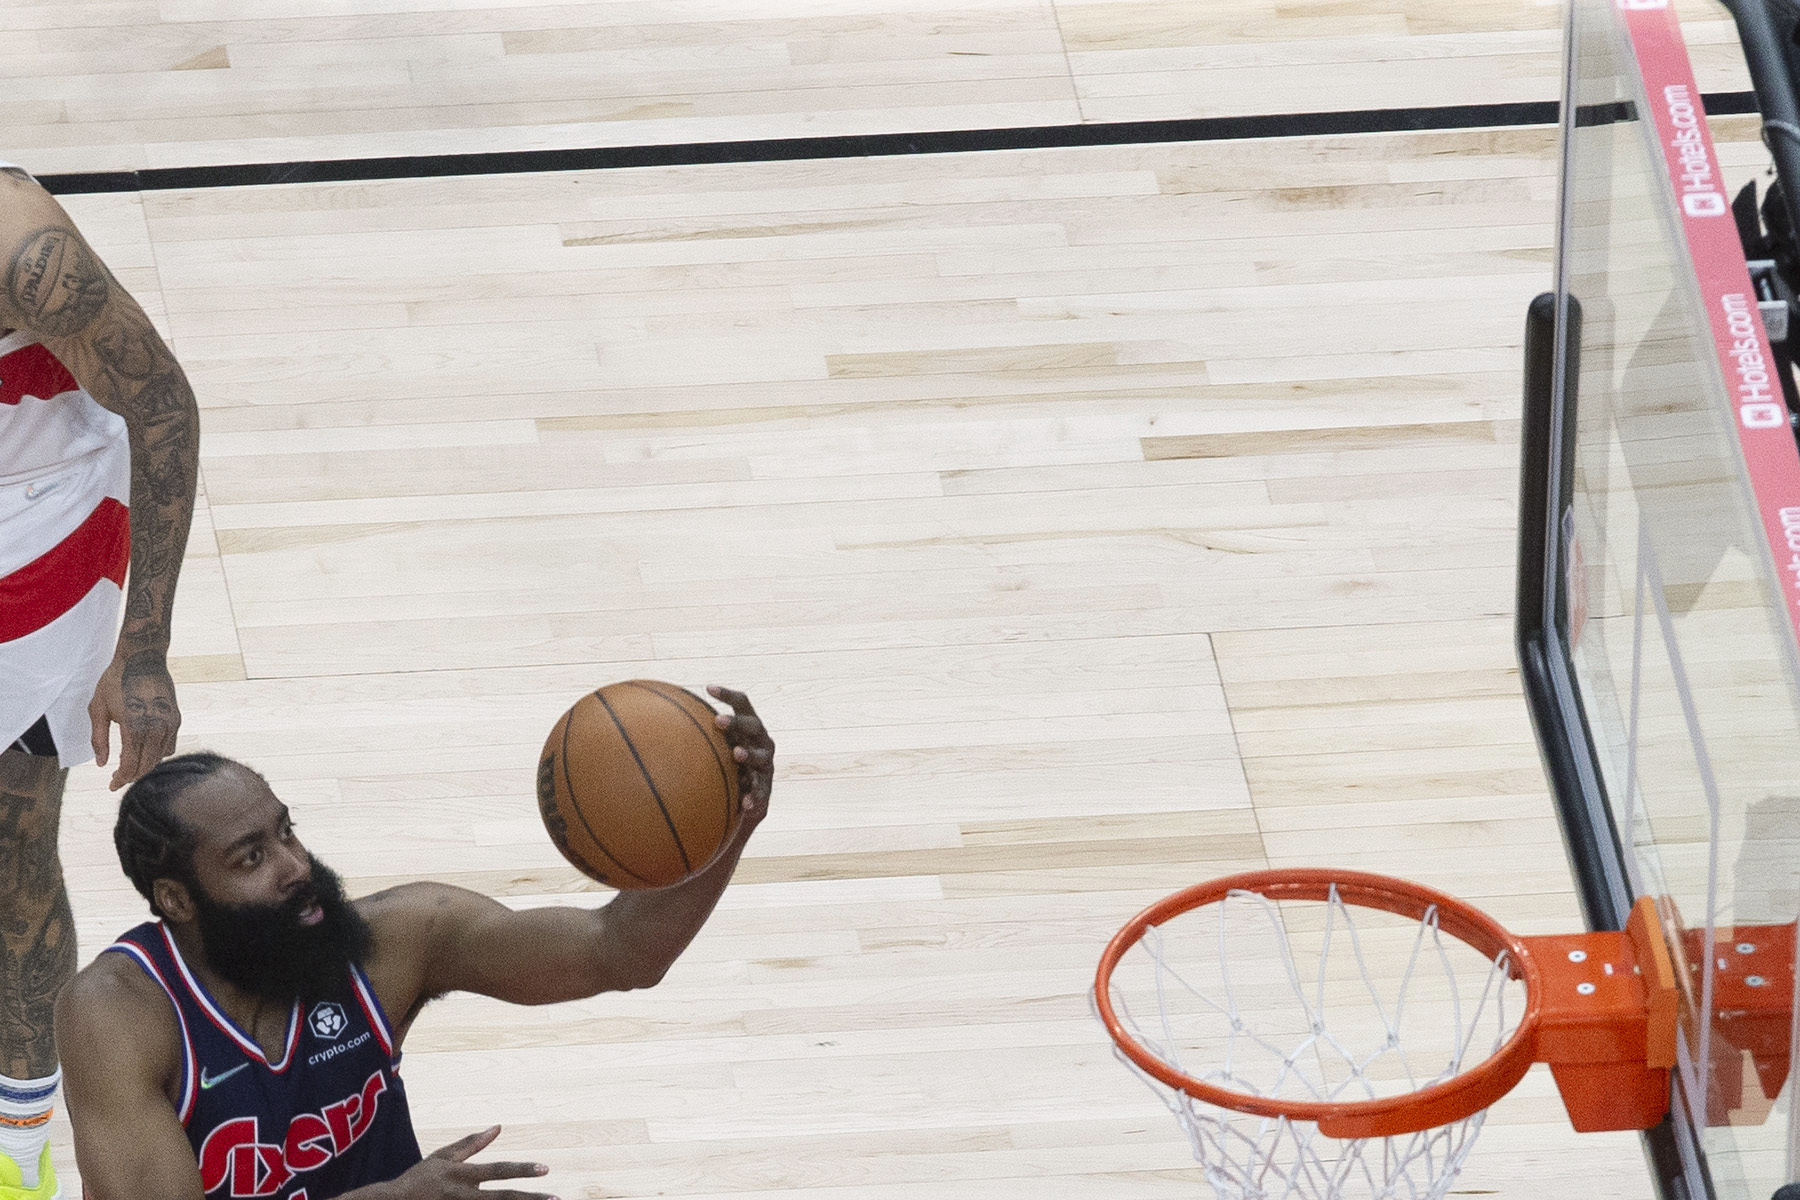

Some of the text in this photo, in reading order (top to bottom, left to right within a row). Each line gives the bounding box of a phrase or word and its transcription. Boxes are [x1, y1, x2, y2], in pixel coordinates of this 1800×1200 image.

[1664, 84, 1716, 192] Hotels.com
[1721, 293, 1774, 403] Hotels.com
[308, 1031, 371, 1065] crypto.com
